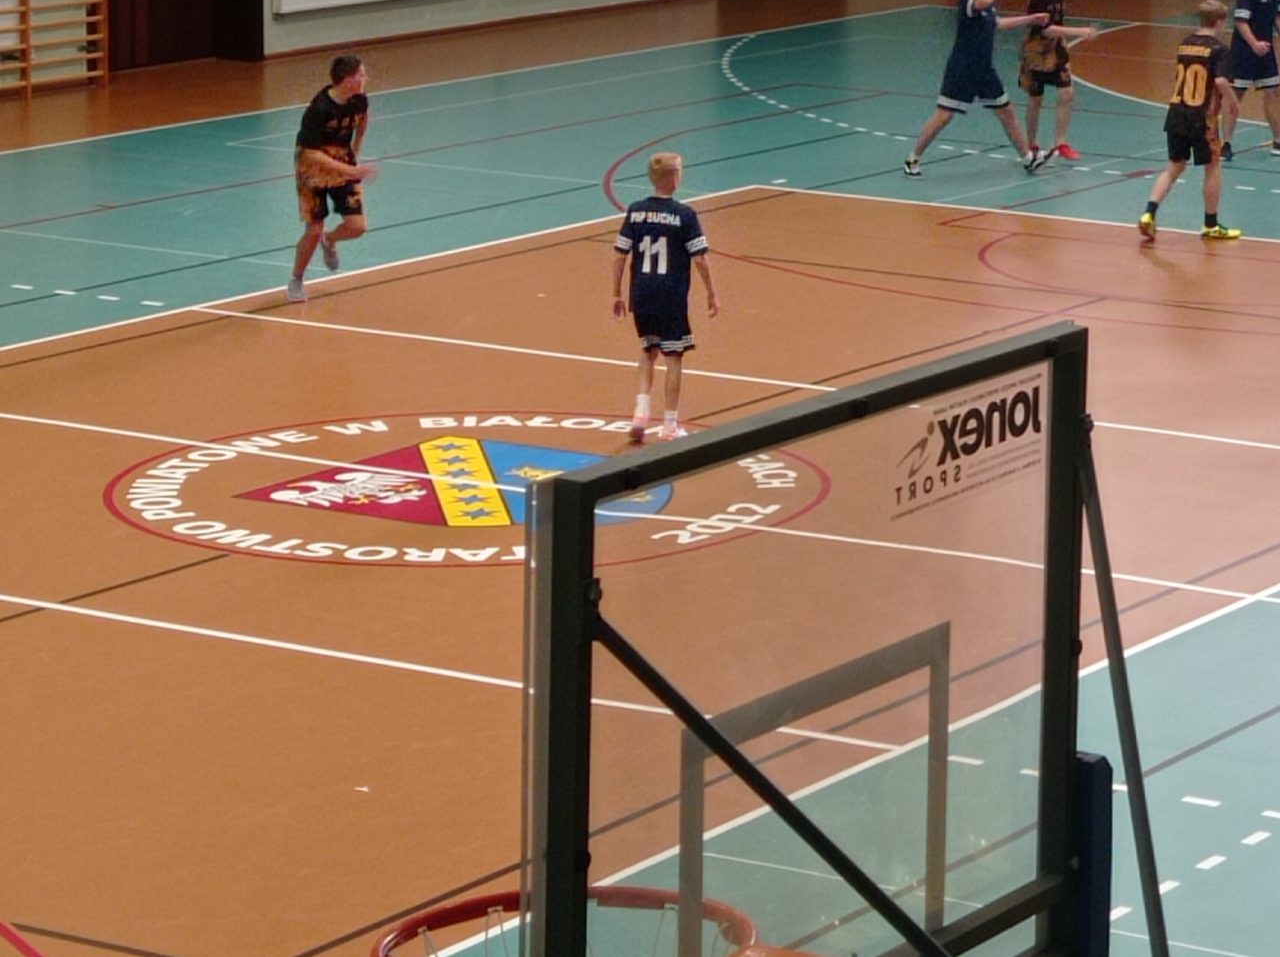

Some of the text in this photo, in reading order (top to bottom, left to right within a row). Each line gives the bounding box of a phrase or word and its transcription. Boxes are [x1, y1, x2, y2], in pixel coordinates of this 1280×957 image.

[1169, 62, 1208, 107] 20
[639, 236, 667, 274] 11
[323, 420, 388, 435] W
[126, 430, 318, 521] POWIATOWE
[172, 521, 526, 562] TAROSTWO
[650, 502, 782, 544] 2012
